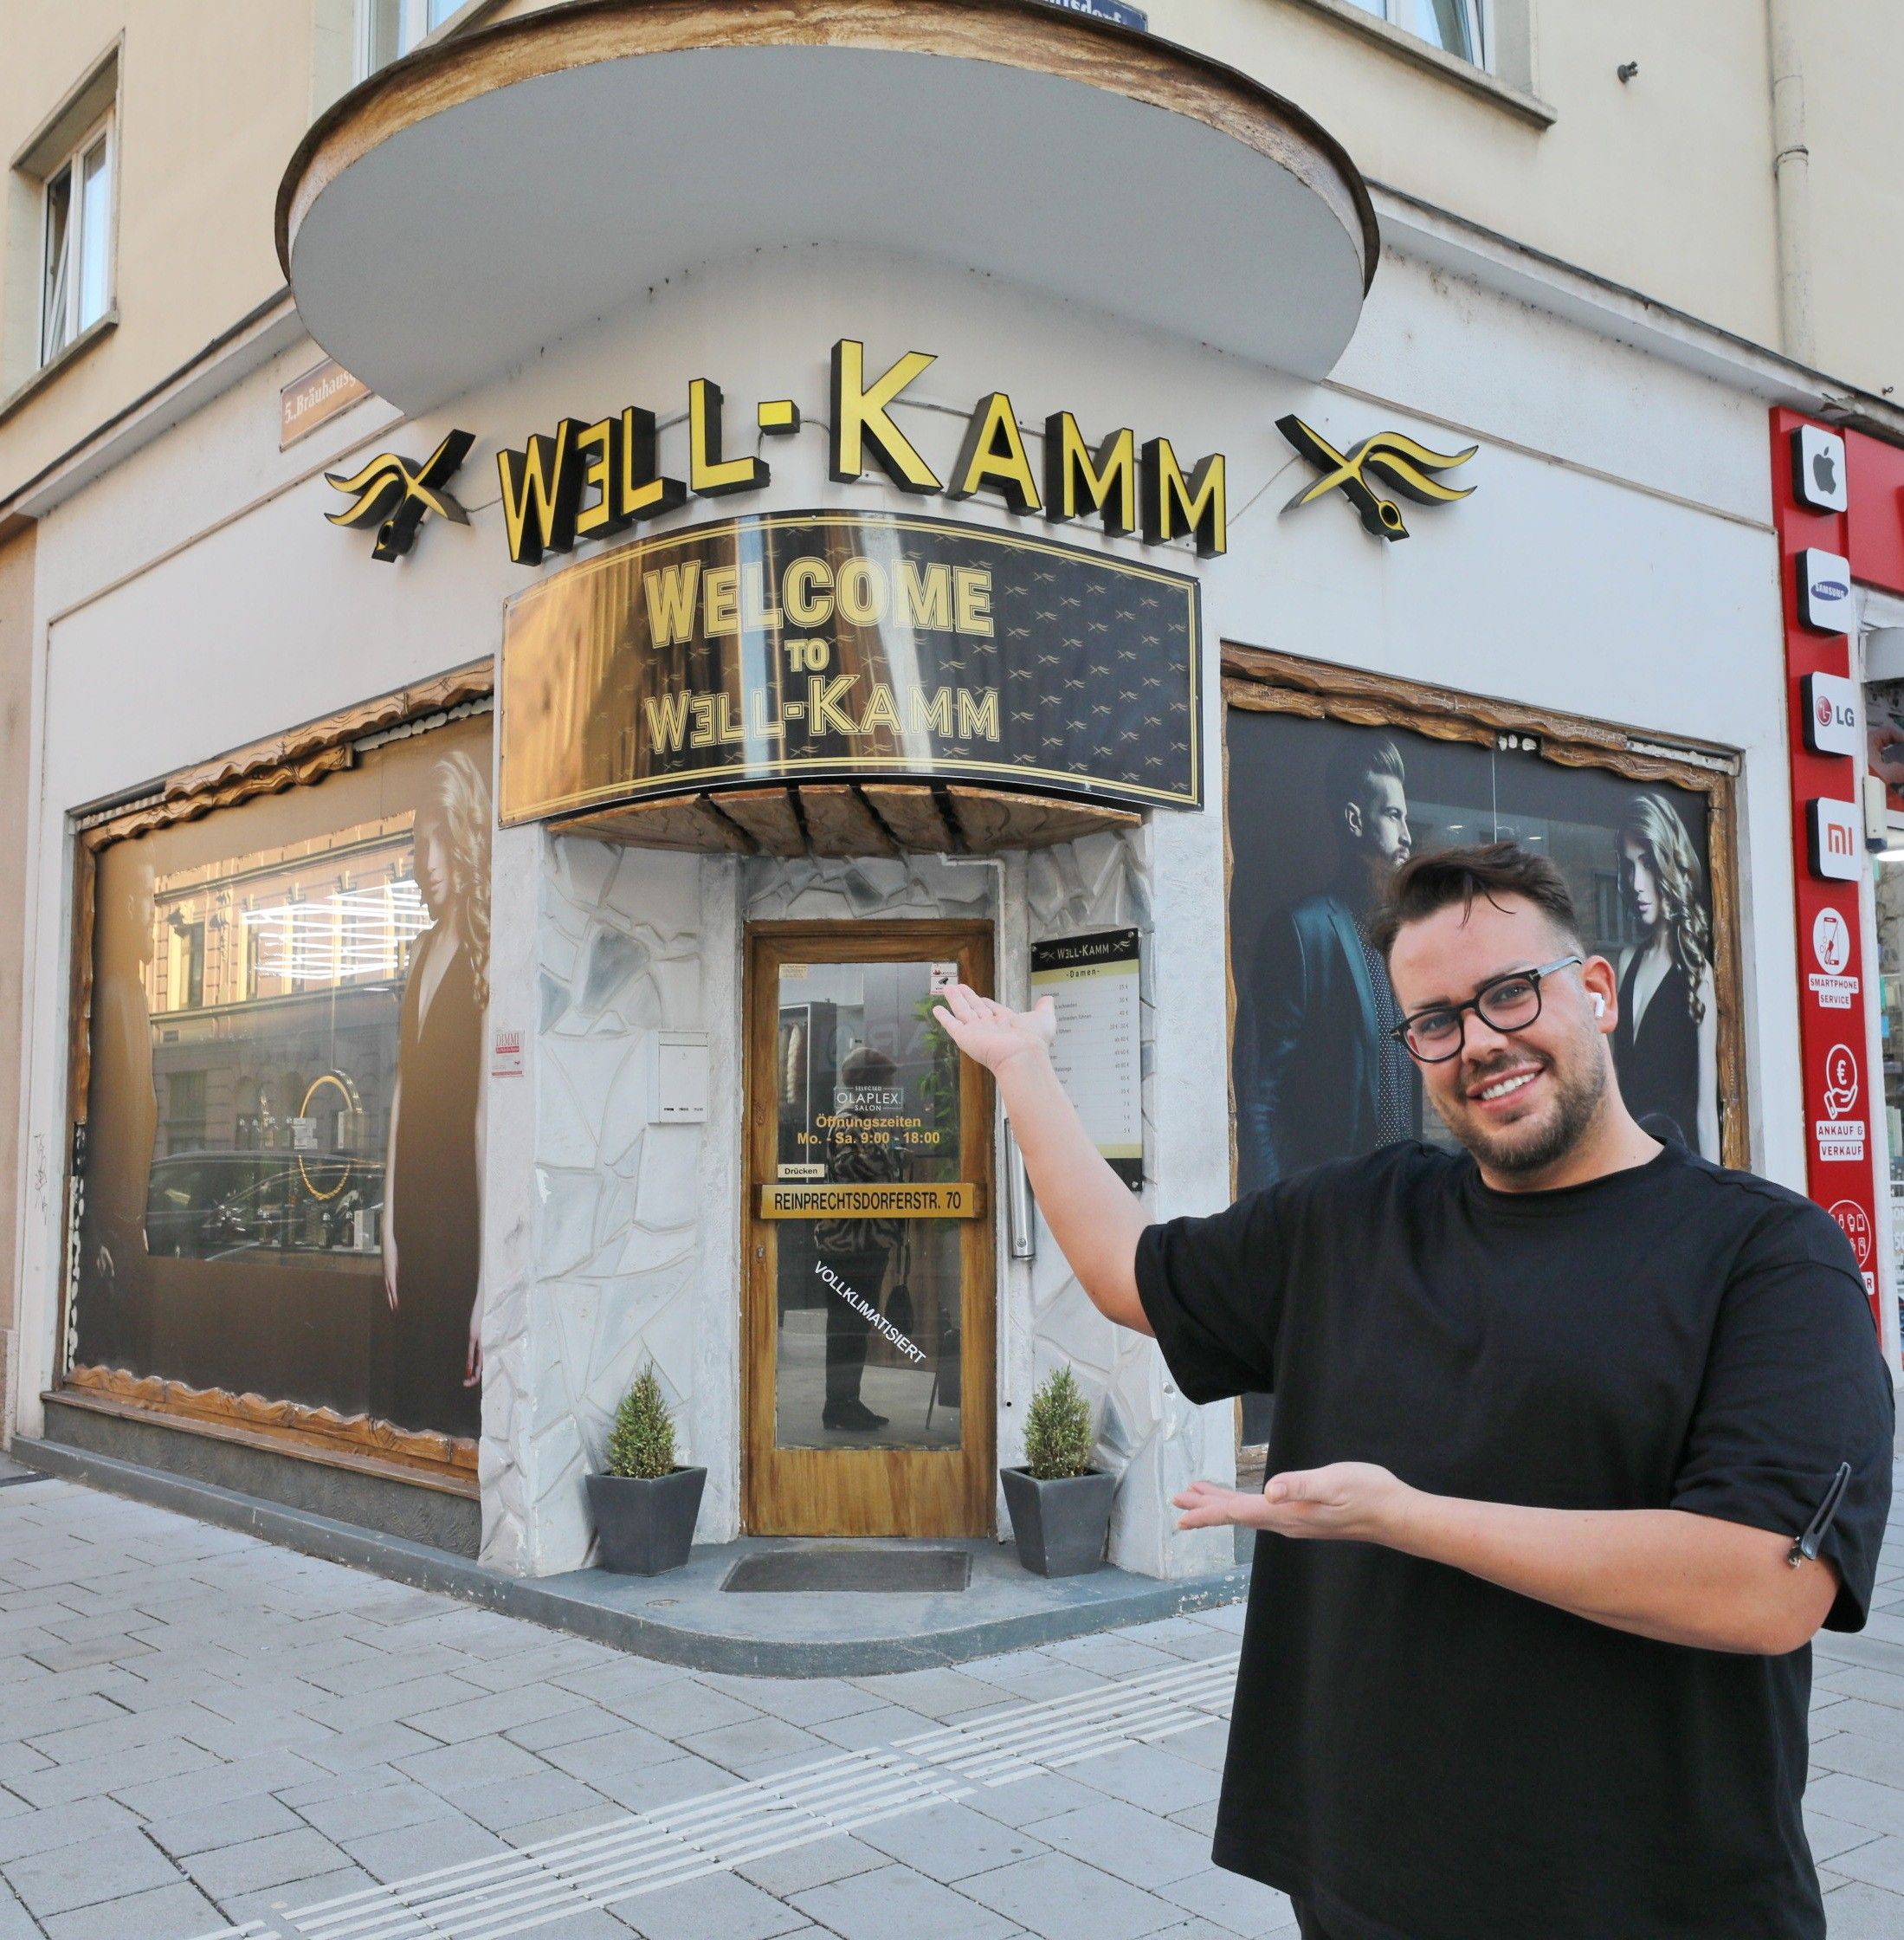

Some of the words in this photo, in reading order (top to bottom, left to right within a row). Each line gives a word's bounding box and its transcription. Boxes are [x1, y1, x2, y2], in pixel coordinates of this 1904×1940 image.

[1815, 582, 1845, 599] SAMSUNG
[643, 557, 995, 649] WELCOME
[784, 638, 829, 672] TO
[1836, 706, 1855, 727] LG
[1810, 979, 1857, 989] SMARTPHONE
[1820, 995, 1849, 1005] SERVICE
[816, 1114, 921, 1130] Öffnungszeiten
[797, 1132, 822, 1144] Mo.
[835, 1132, 856, 1144] Sa.
[861, 1132, 890, 1144] 9:00
[903, 1132, 940, 1144] 18:00
[1818, 1126, 1856, 1135] ANKAUF
[1857, 1126, 1863, 1135] &
[1821, 1146, 1862, 1156] VERKAUF
[775, 1192, 941, 1211] REINPRECHTSDORFERSTR.
[946, 1191, 961, 1209] 70
[814, 1260, 926, 1363] VOLLKLIMATISIERT
